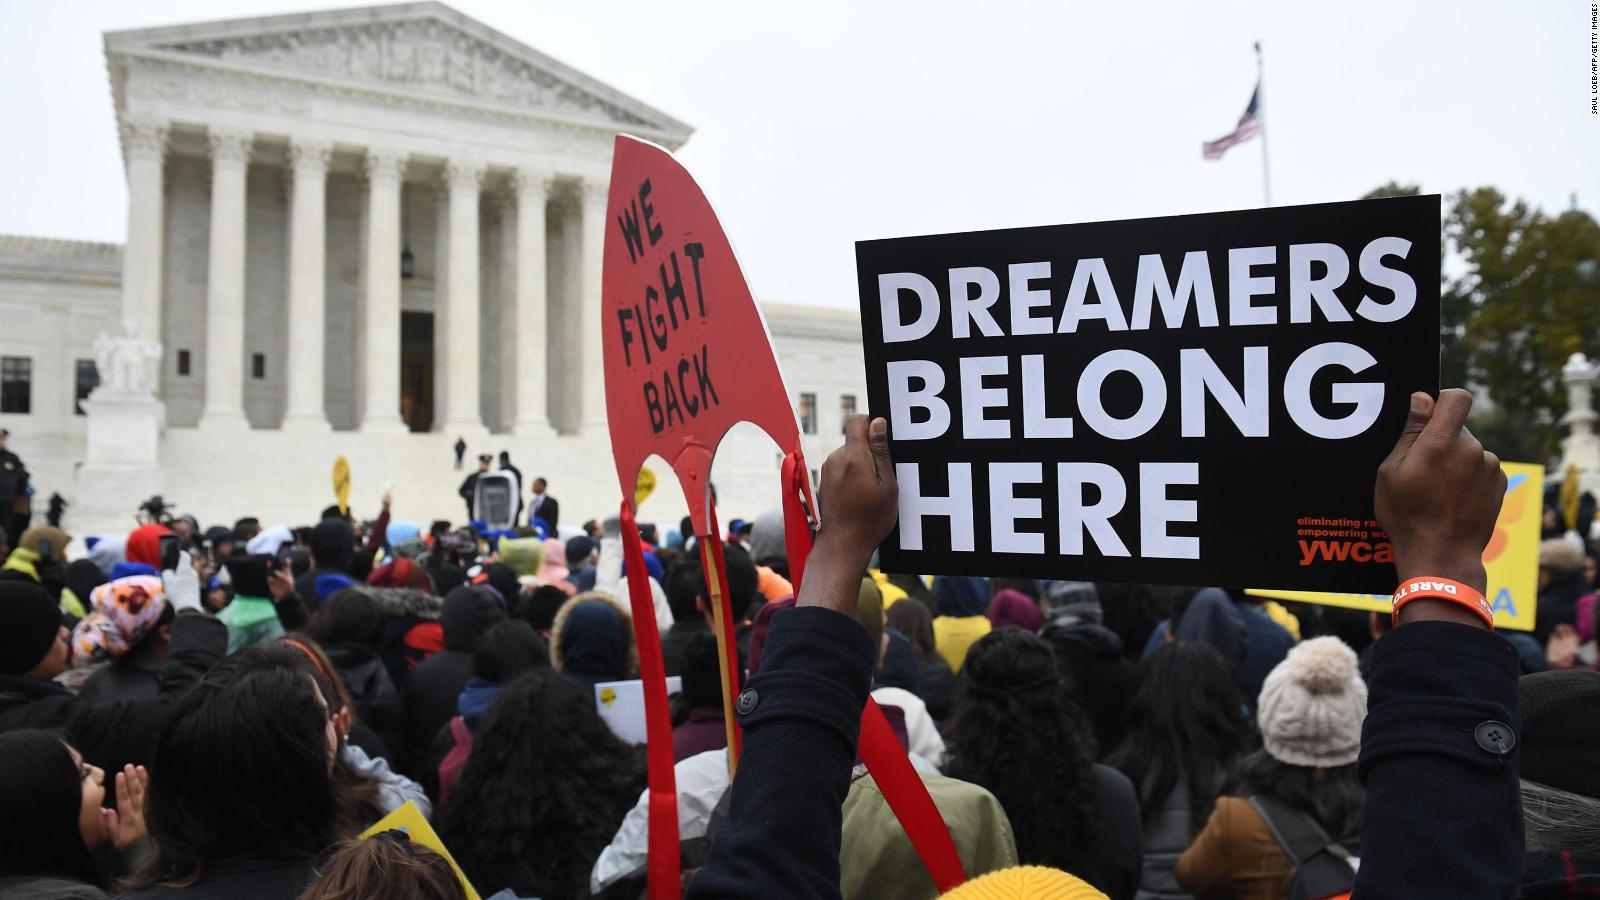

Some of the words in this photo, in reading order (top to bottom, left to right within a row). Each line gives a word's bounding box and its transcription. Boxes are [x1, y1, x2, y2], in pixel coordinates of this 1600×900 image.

[617, 178, 663, 265] WE
[617, 242, 706, 367] FIGHT
[878, 236, 1417, 343] DREAMERS
[643, 345, 720, 434] BACK
[886, 341, 1386, 440] BELONG
[896, 462, 1200, 560] HERE
[1297, 517, 1361, 528] eliminating
[1297, 528, 1368, 539] empowering
[1298, 540, 1395, 566] ywca
[1410, 581, 1457, 596] DARE
